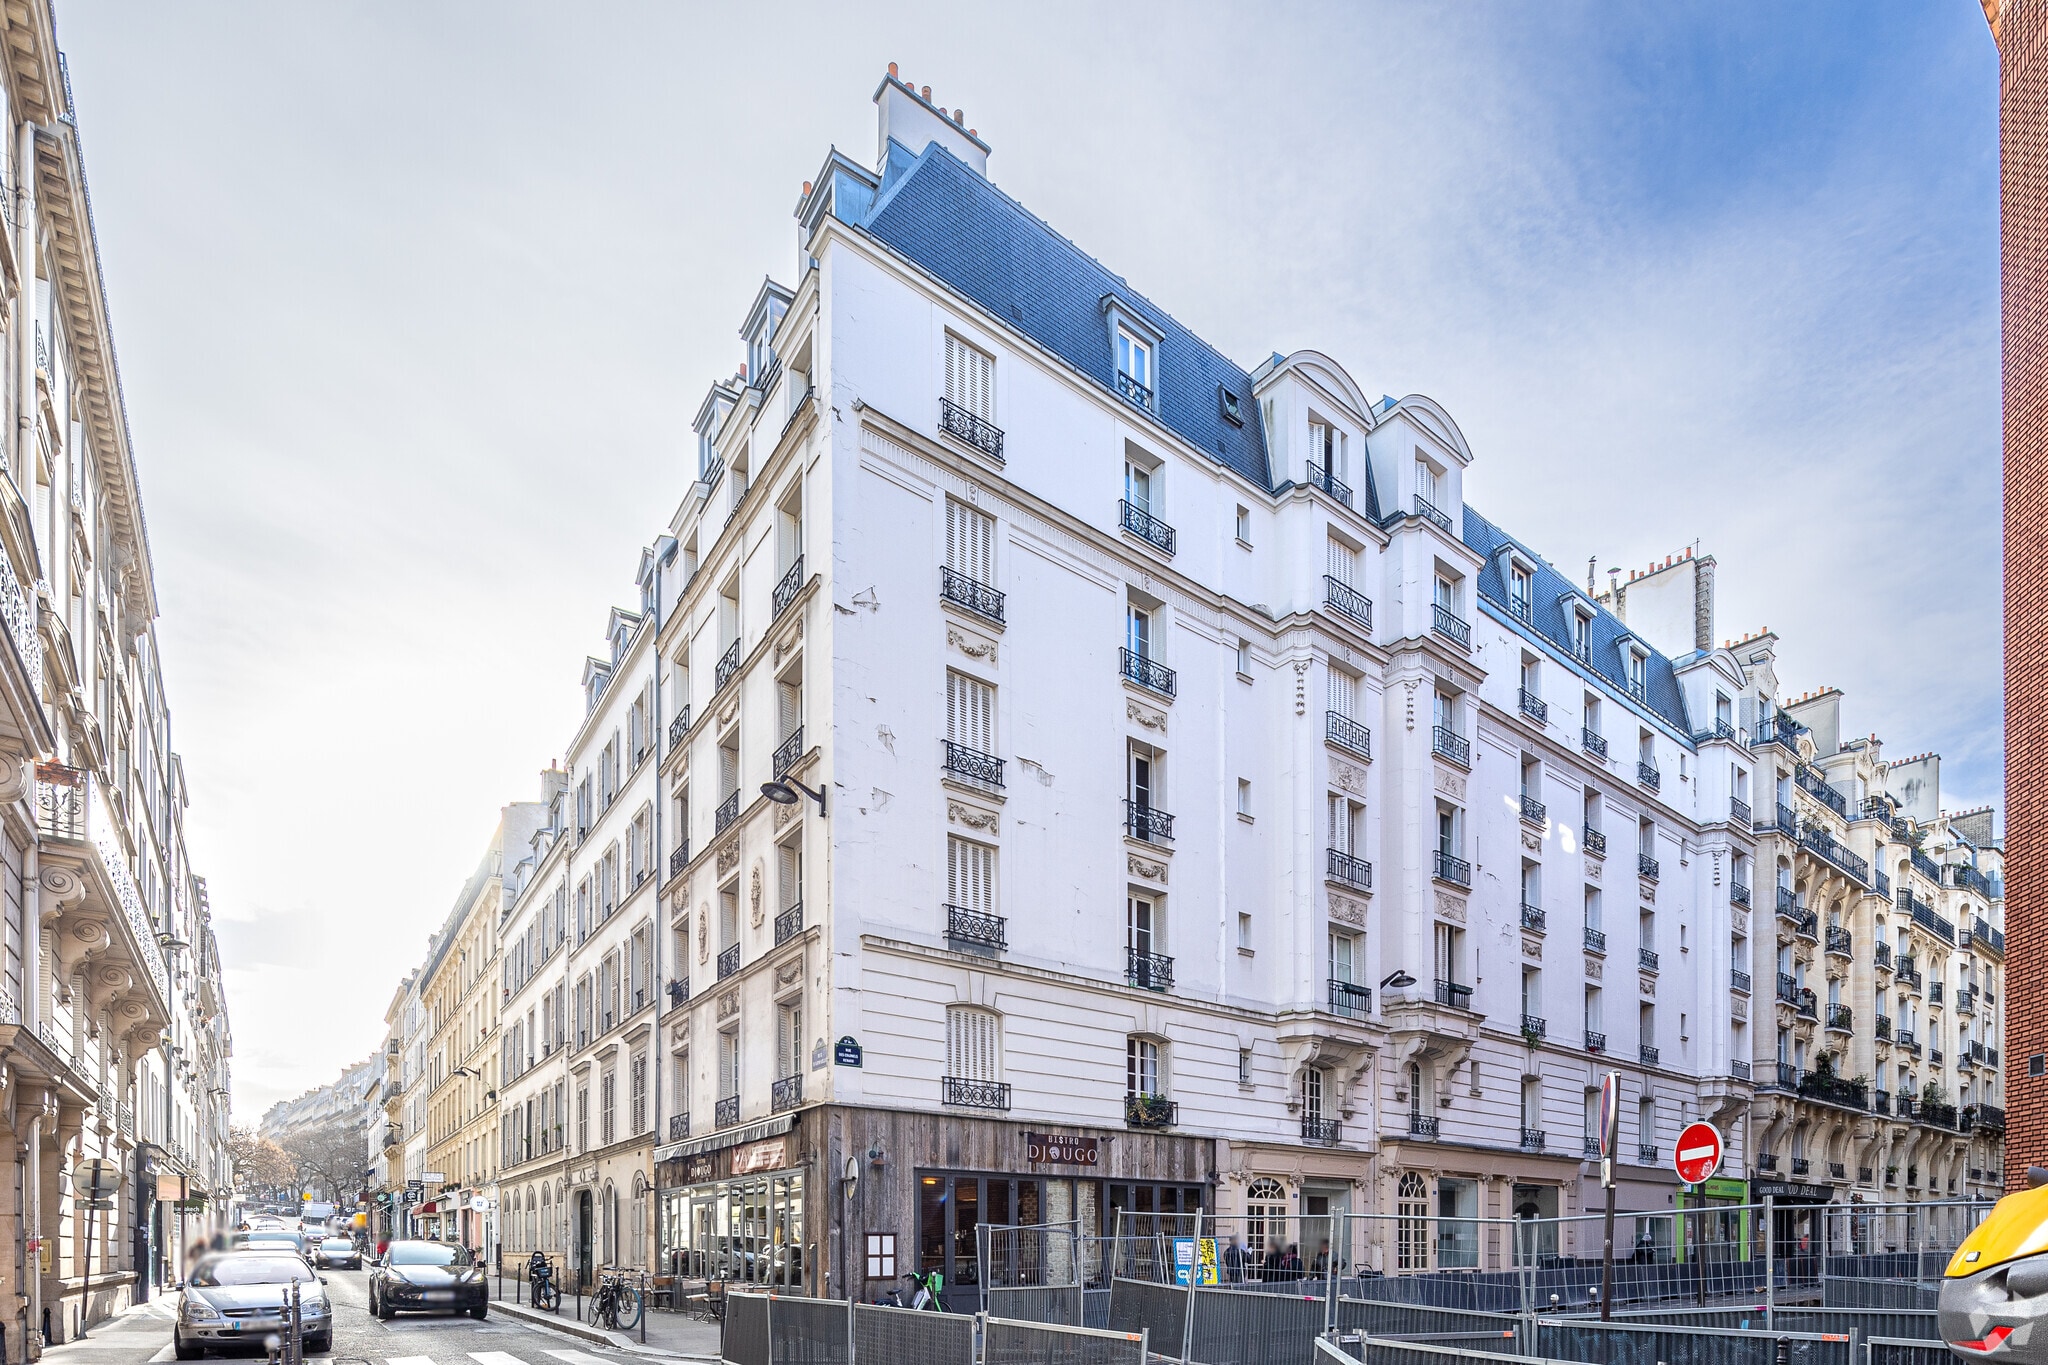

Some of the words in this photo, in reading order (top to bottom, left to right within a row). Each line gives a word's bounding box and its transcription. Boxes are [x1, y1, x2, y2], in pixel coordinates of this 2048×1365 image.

[1048, 1135, 1079, 1146] BISTRO
[1759, 1186, 1772, 1194] GOOD
[1772, 1186, 1785, 1194] DEAL
[1801, 1185, 1818, 1197] DEAL
